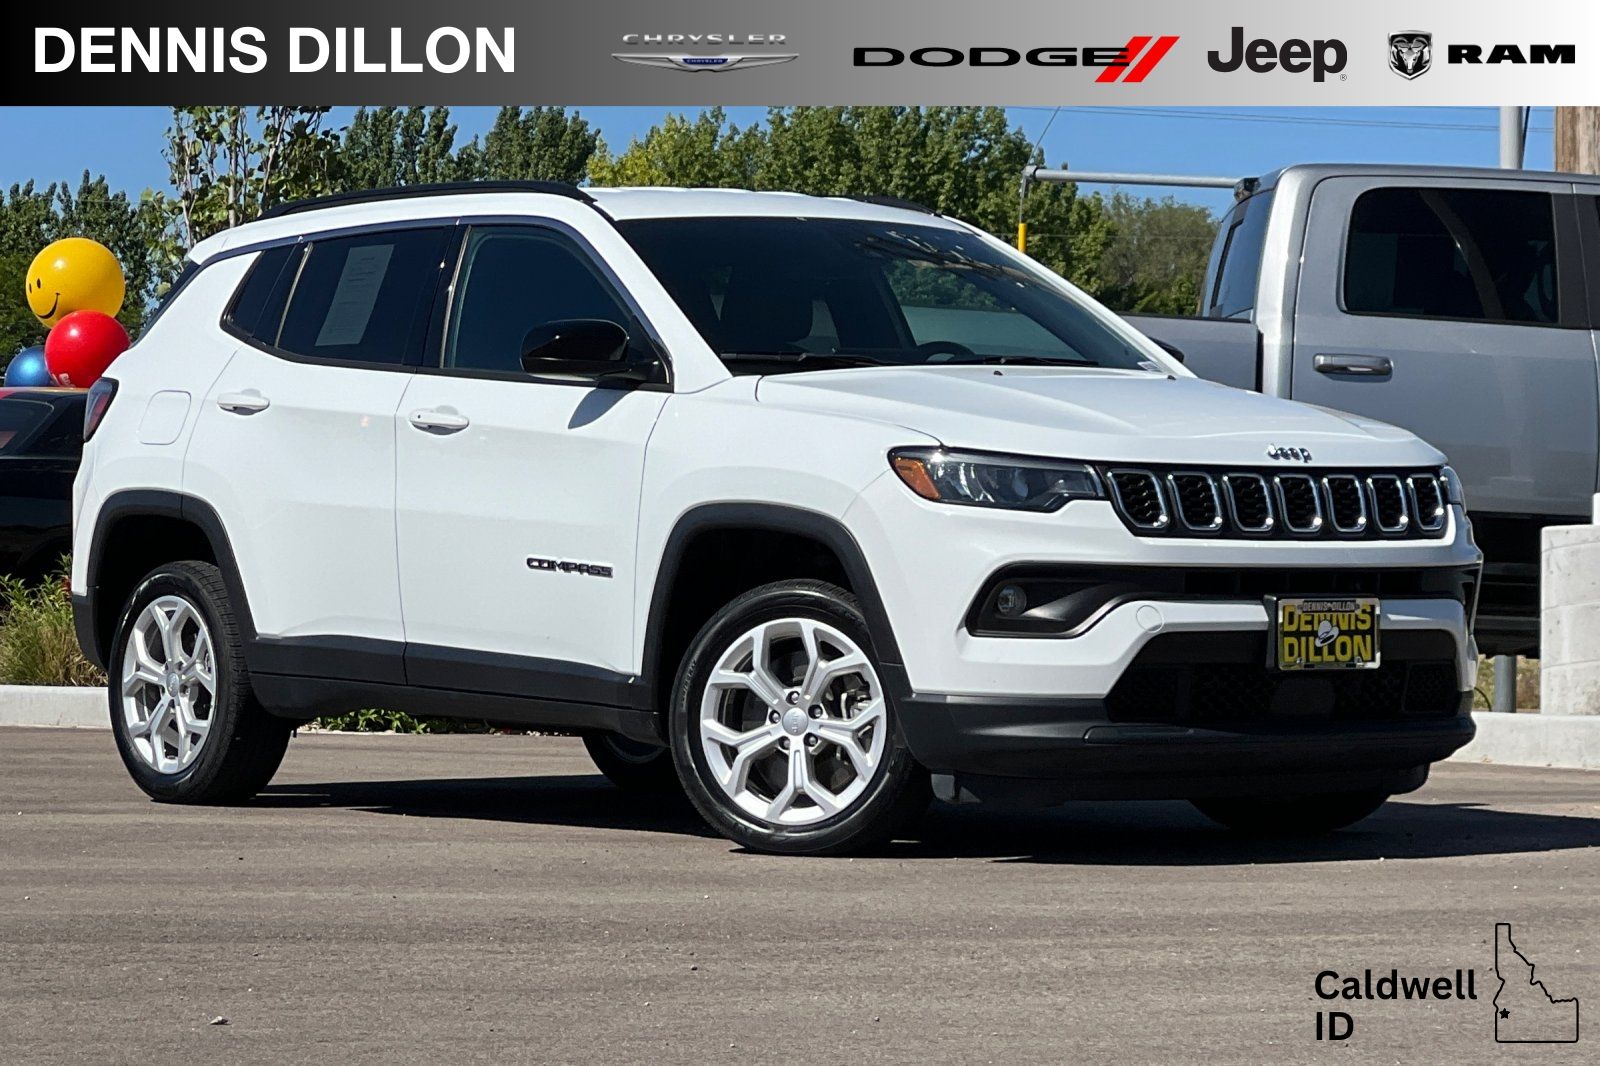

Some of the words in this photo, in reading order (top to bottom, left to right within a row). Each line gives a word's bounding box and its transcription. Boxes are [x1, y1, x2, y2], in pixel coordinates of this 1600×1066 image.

[1266, 443, 1313, 463] Jeep
[526, 557, 613, 578] COMPASS
[1303, 601, 1327, 611] DENNIS
[1332, 601, 1356, 611] DILLON
[1283, 635, 1372, 662] DILLON
